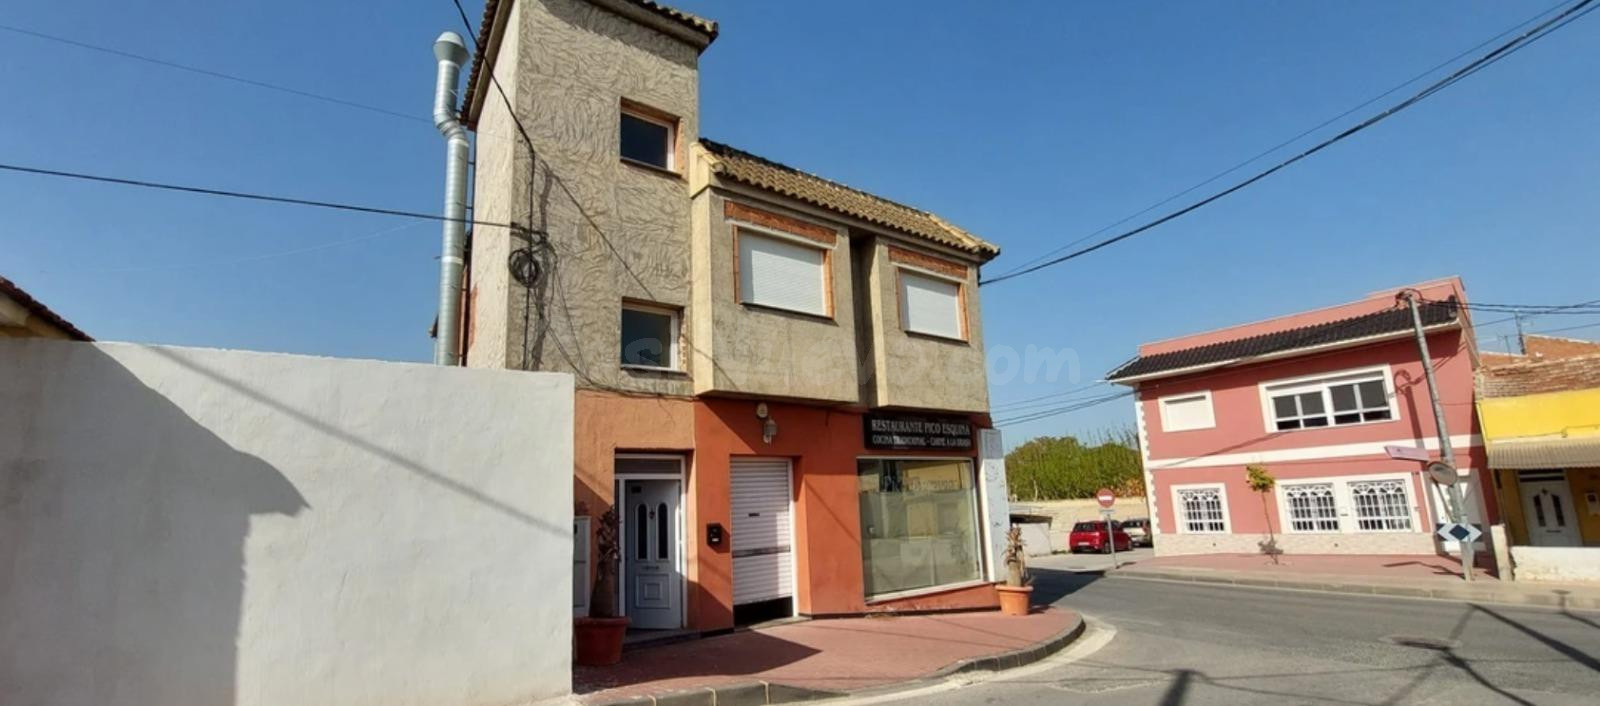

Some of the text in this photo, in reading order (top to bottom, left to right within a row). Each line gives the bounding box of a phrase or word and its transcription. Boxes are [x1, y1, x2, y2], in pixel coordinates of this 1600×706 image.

[872, 419, 970, 436] RESTAURANTE PICO ESQUINA
[872, 435, 893, 445] COCINA
